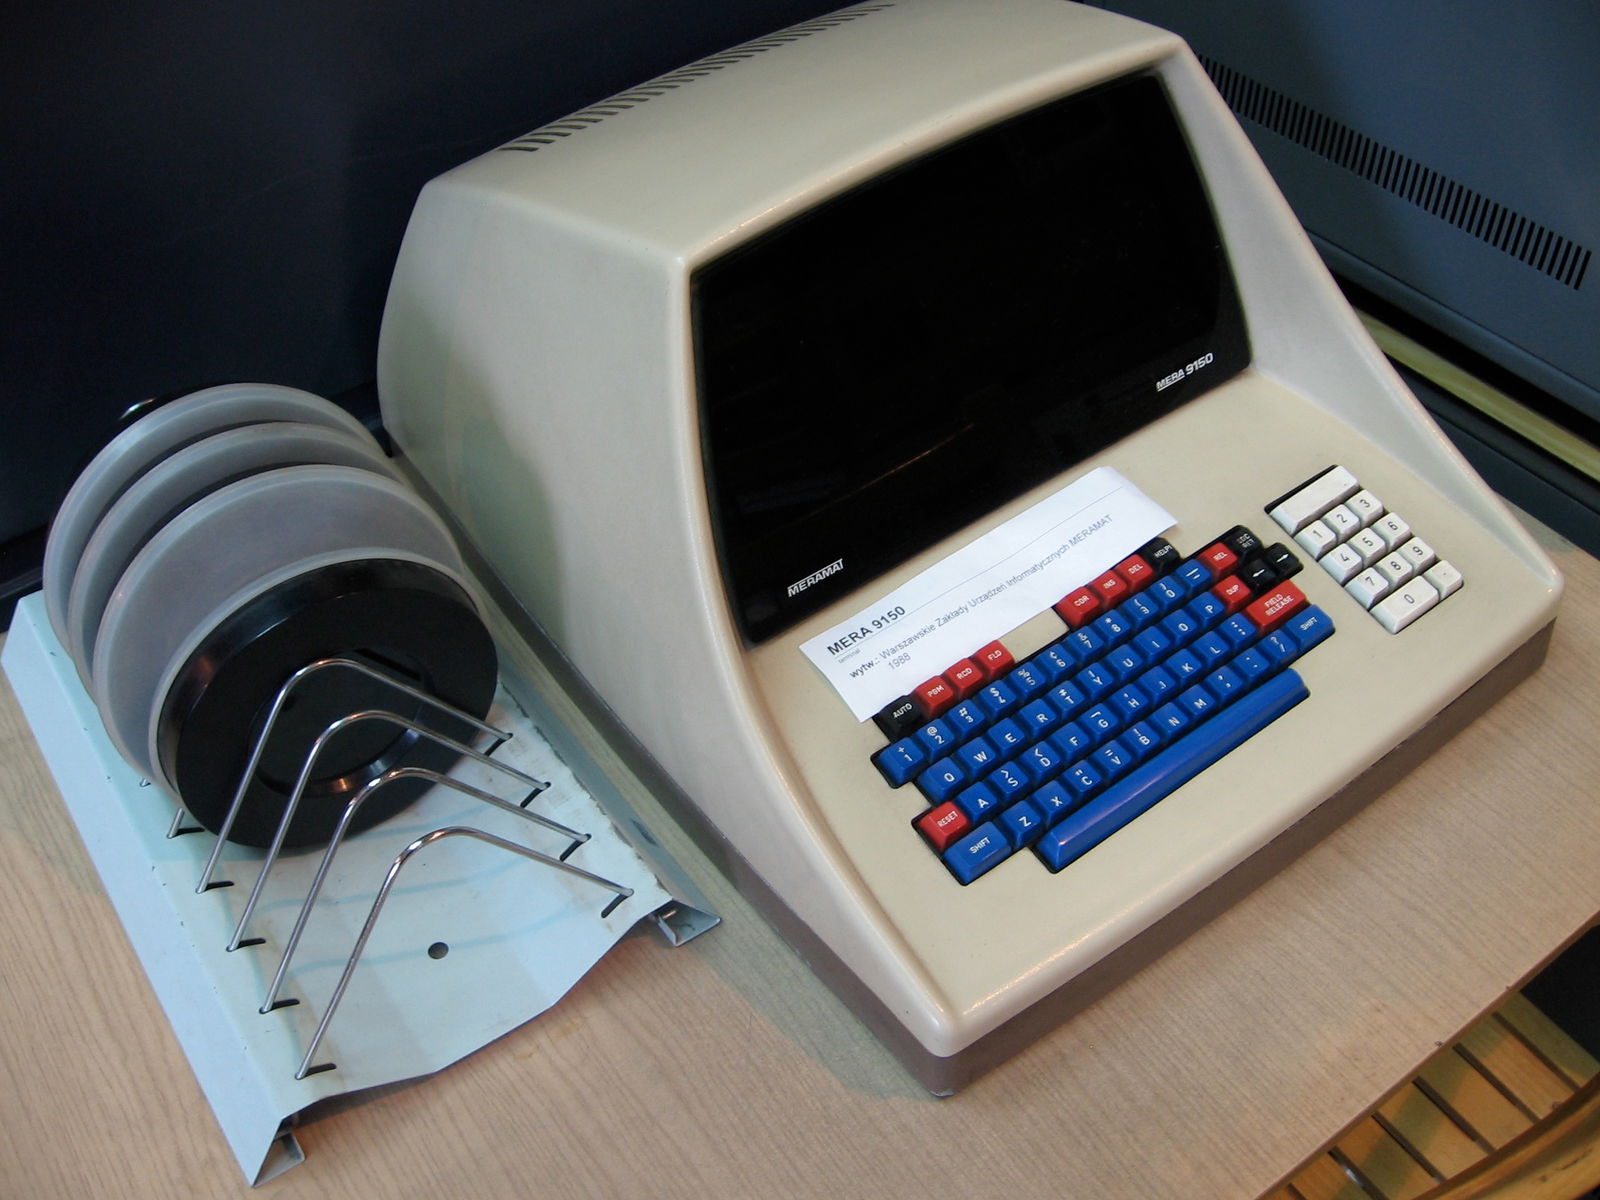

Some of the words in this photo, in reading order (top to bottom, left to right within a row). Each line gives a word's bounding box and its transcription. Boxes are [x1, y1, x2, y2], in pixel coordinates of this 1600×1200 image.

[1156, 368, 1185, 392] MERA
[1185, 352, 1214, 375] 9150
[1360, 498, 1370, 508] 3
[1336, 514, 1348, 524] 2
[1388, 522, 1398, 530] 6
[1312, 530, 1322, 538] 1
[1362, 536, 1374, 546] 5
[1412, 546, 1424, 556] 9
[1340, 554, 1350, 562] 4
[1128, 564, 1144, 574] DEL
[1390, 562, 1402, 570] 8
[787, 558, 844, 597] MERAMAT
[1364, 576, 1374, 584] 7
[879, 623, 936, 660] Warszawskie
[1006, 541, 1071, 587] Informatycznych
[1068, 514, 1113, 546] MERAMAT
[1264, 594, 1284, 608] FIELD
[1404, 594, 1416, 604] 0
[1204, 604, 1214, 614] P
[1265, 595, 1294, 616] RELEASE
[1178, 624, 1188, 632] O
[1300, 616, 1318, 631] SHIFT
[827, 626, 873, 656] MERA
[871, 606, 906, 629] 9150
[988, 650, 1002, 660] FLD
[888, 652, 912, 670] 1988
[1122, 658, 1134, 668] U
[956, 668, 972, 680] RCD
[1092, 675, 1103, 685] Y
[1065, 695, 1075, 704] T
[1194, 698, 1206, 708] M
[892, 702, 912, 718] AUTO
[1036, 714, 1048, 722] R
[1168, 716, 1180, 726] N
[1004, 732, 1016, 742] E
[1139, 735, 1151, 745] B
[974, 752, 988, 762] W
[944, 772, 954, 782] Q
[978, 798, 988, 808] A
[1052, 796, 1062, 806] X
[937, 810, 958, 828] RESET
[1018, 816, 1032, 826] Z
[970, 837, 990, 854] SHIFT
